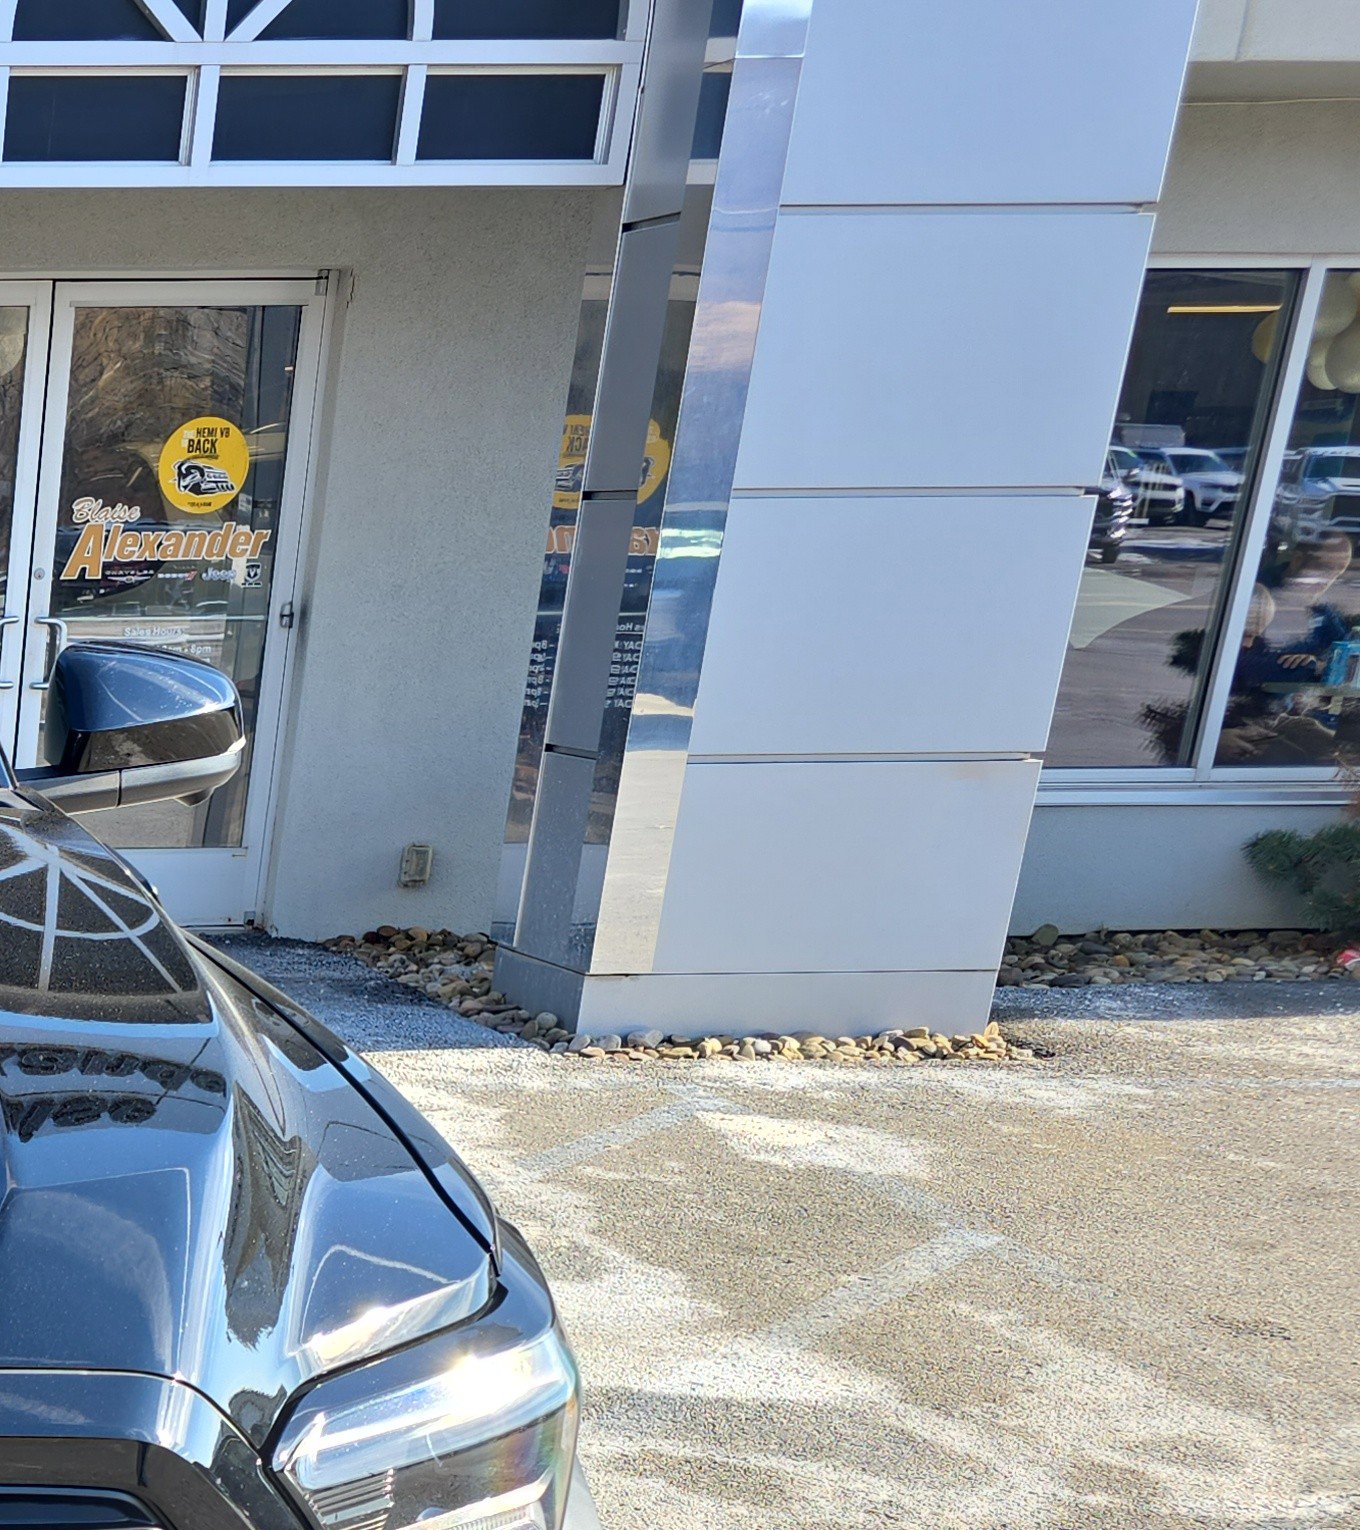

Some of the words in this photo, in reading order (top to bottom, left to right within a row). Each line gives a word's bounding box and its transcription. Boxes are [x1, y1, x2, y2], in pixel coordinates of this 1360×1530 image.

[195, 427, 218, 439] HEMI
[187, 438, 219, 454] BACK
[72, 496, 141, 524] Blaise
[60, 521, 271, 580] Alexander
[201, 566, 237, 585] Jeep
[124, 627, 151, 637] Sales
